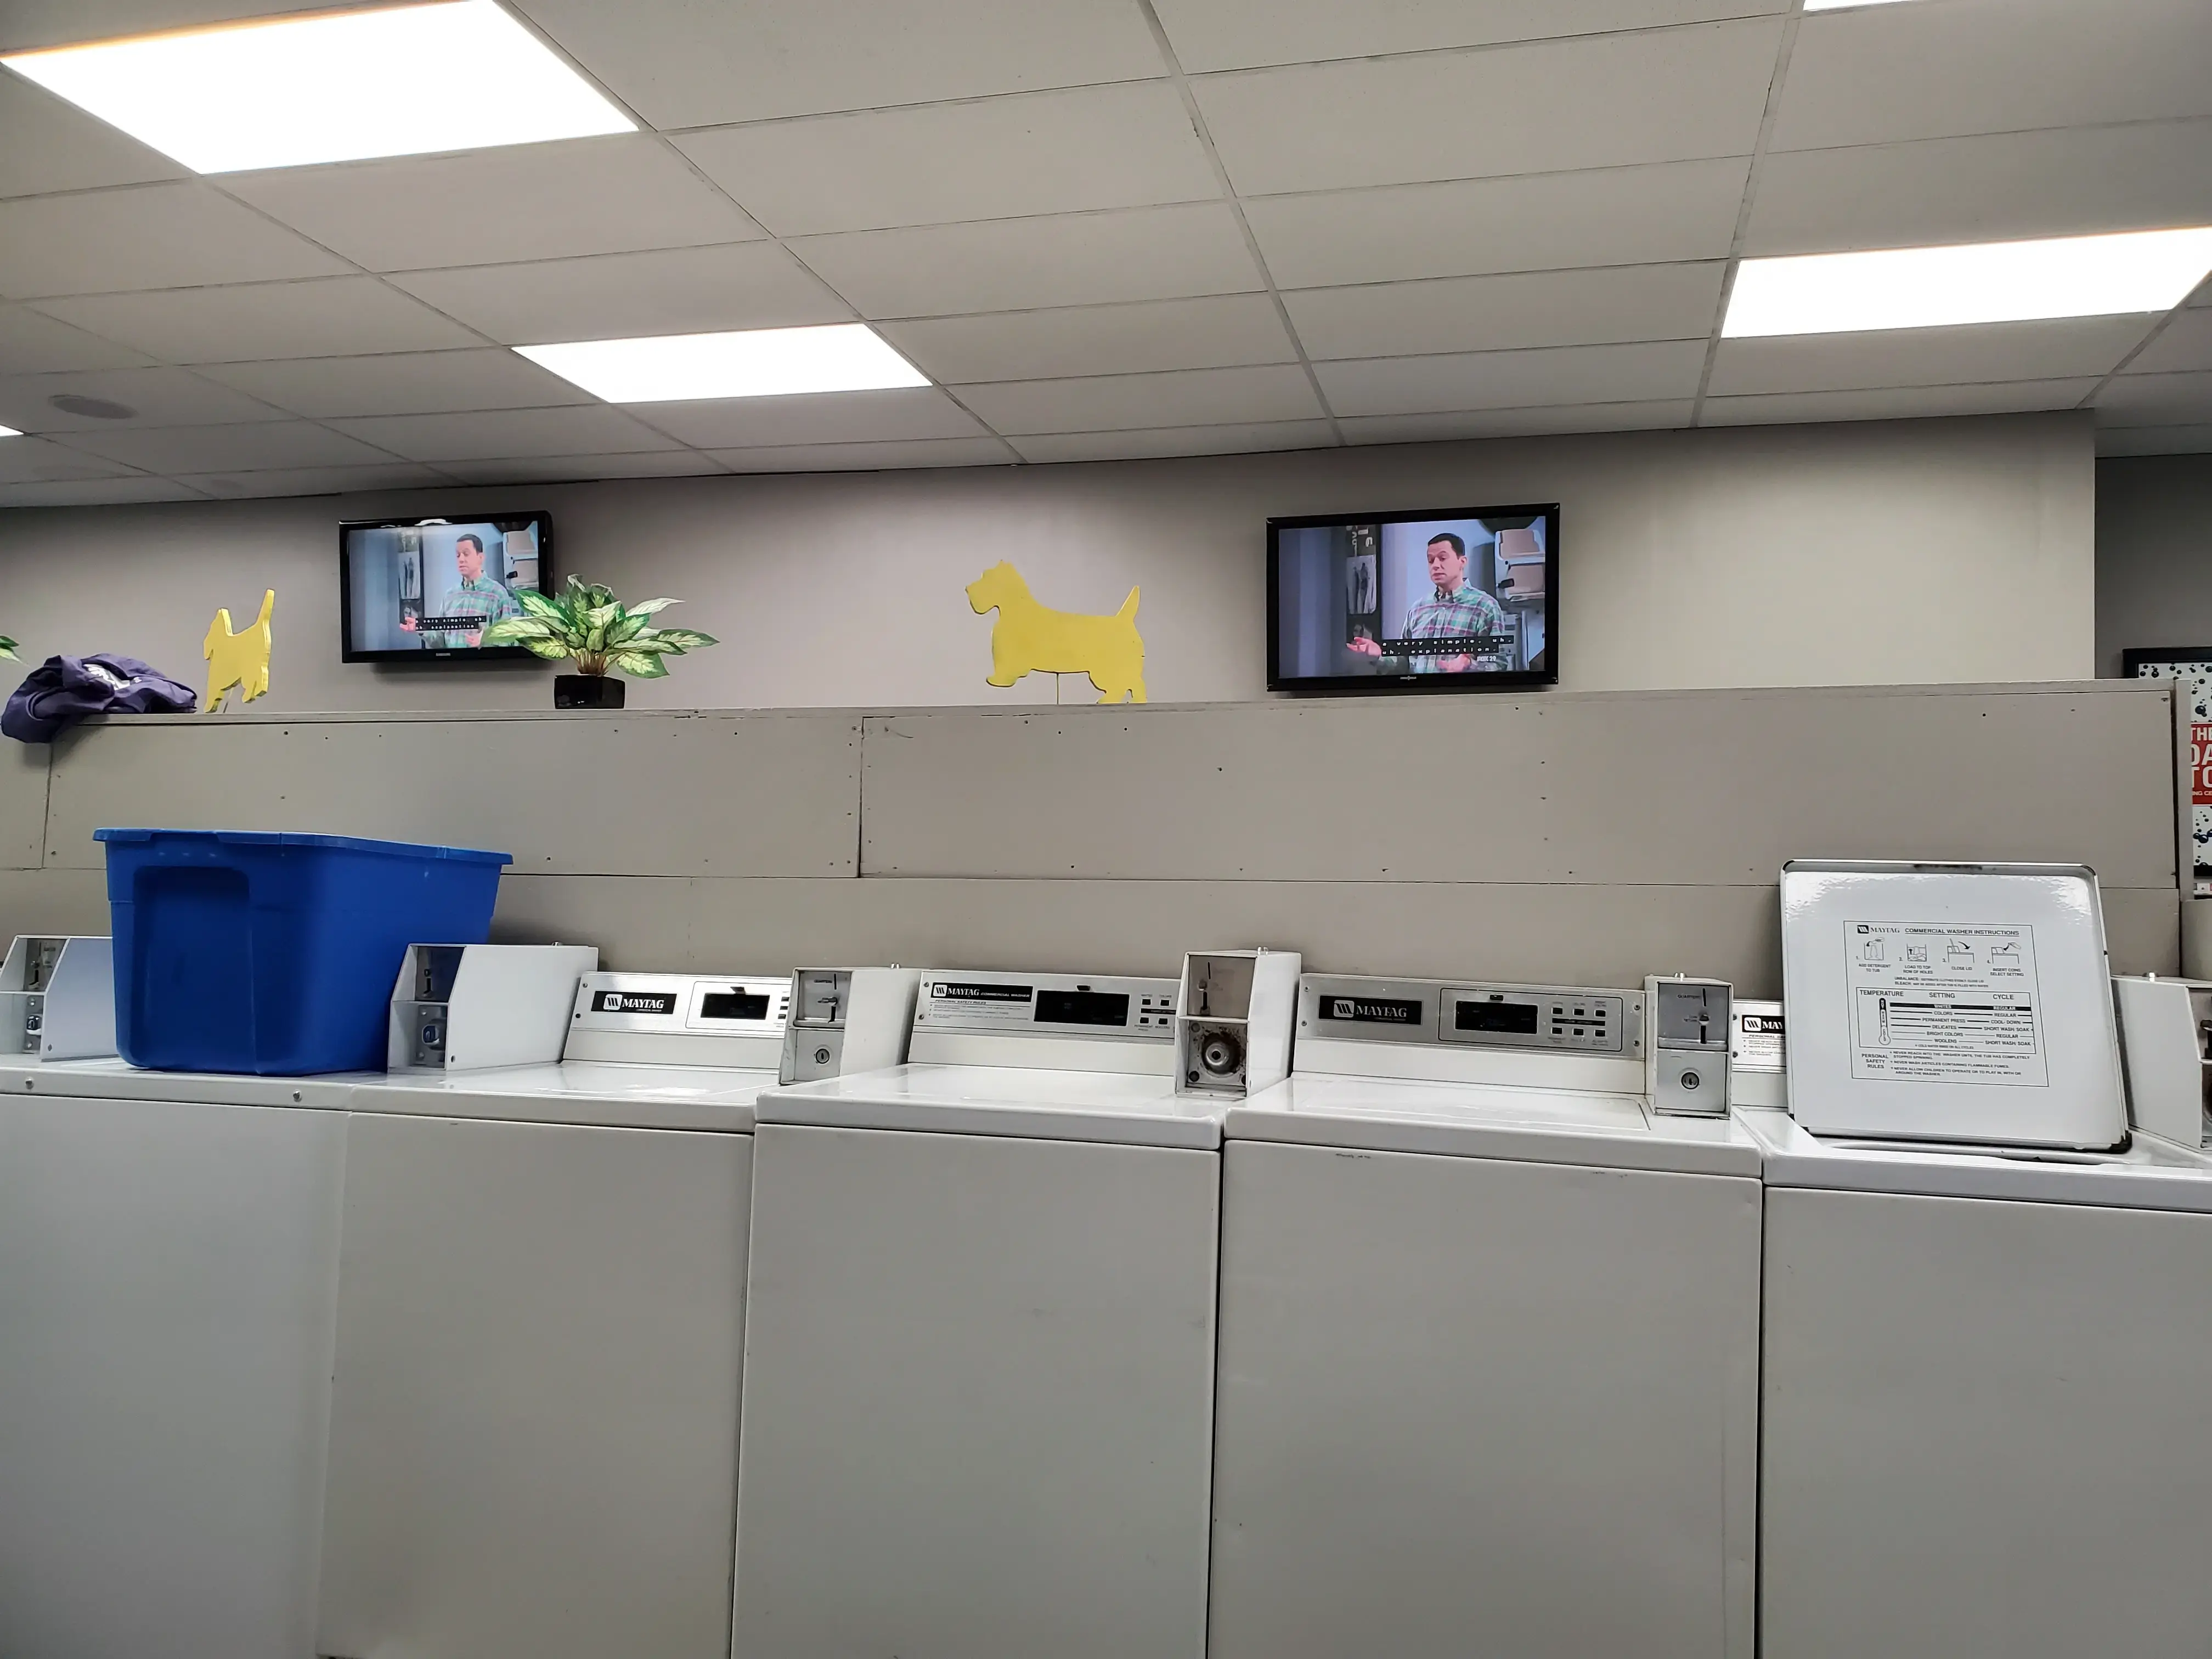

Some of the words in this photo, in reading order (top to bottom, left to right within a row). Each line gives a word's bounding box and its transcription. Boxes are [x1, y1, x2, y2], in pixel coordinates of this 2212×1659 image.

[947, 988, 980, 996] MAYTAG
[622, 998, 664, 1009] MAYTAG
[1356, 1005, 1407, 1018] MAYTAG
